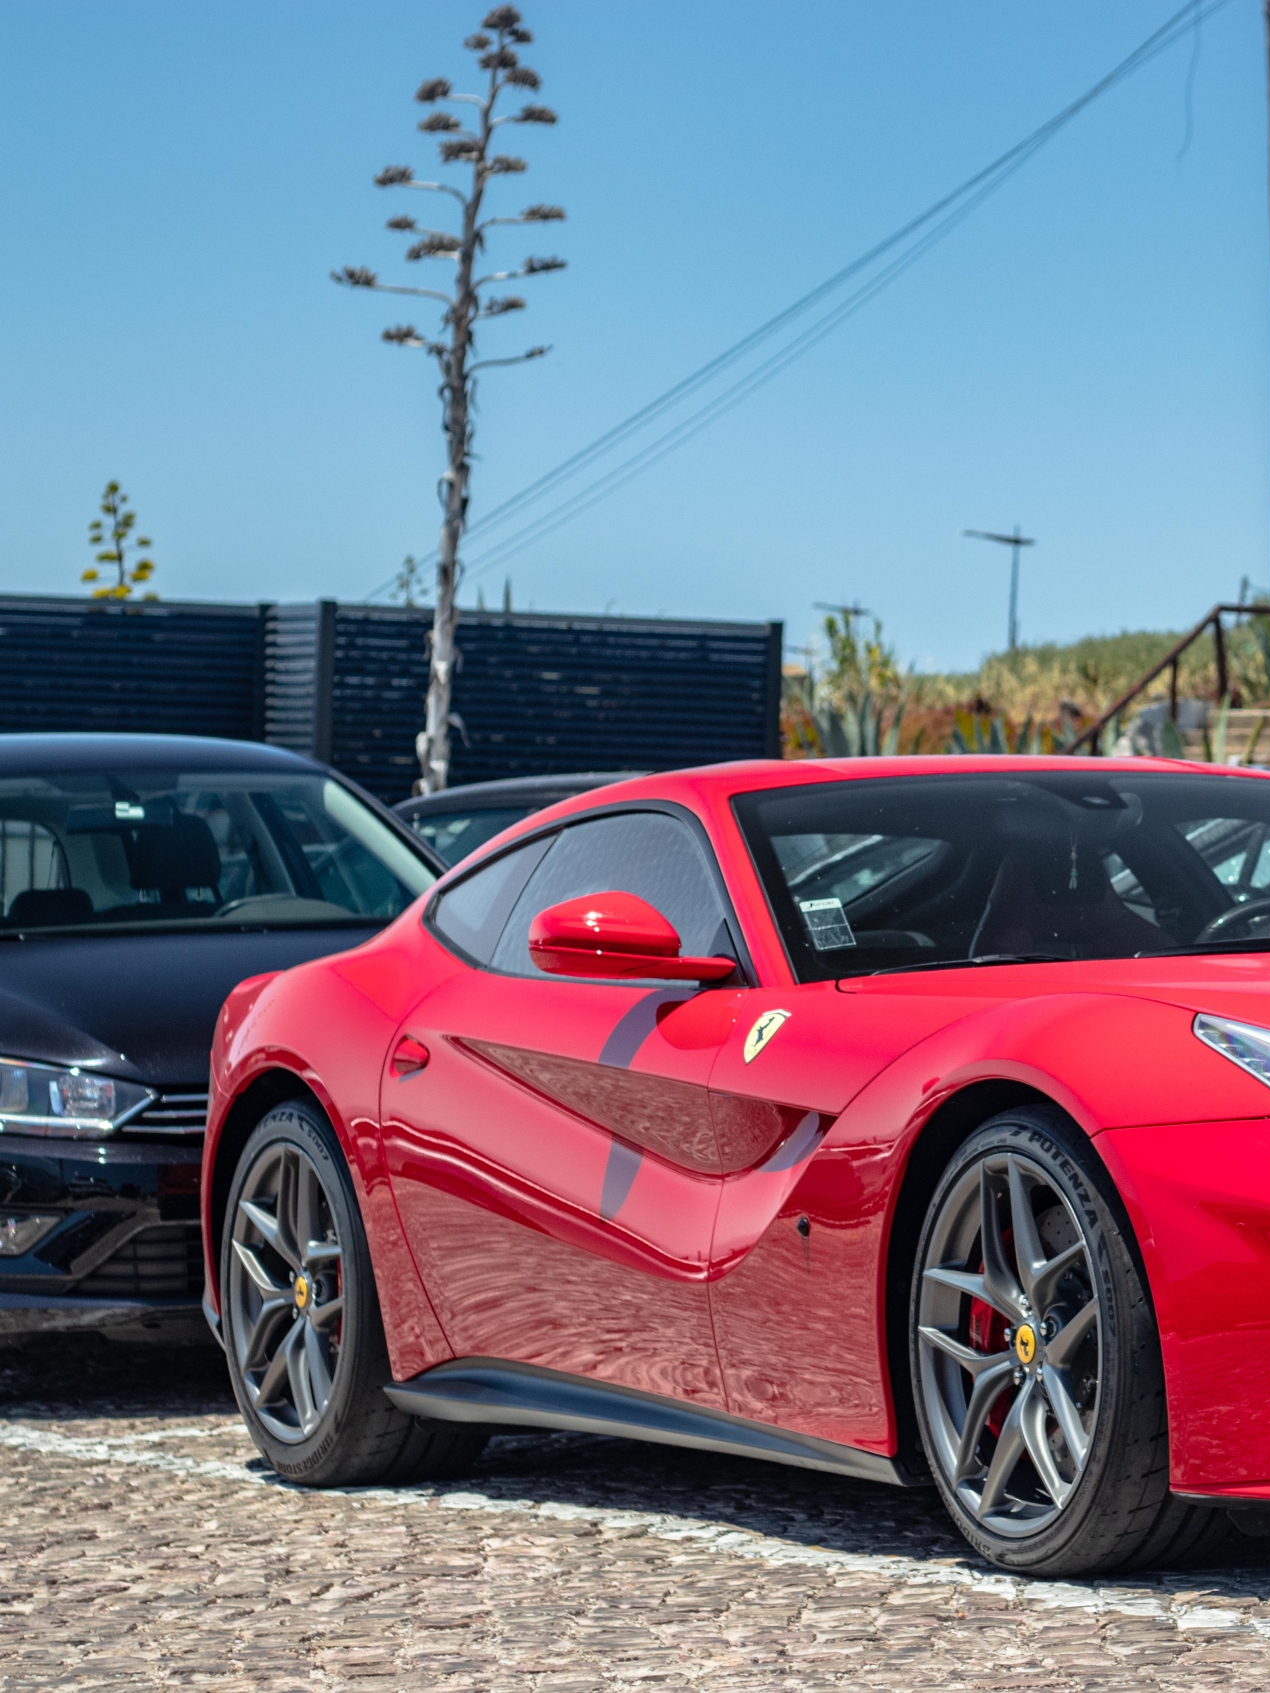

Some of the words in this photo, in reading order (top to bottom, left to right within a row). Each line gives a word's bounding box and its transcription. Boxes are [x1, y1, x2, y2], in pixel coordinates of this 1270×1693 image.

[306, 1129, 330, 1162] S007
[1027, 1130, 1099, 1229] POTENZA
[1101, 1269, 1117, 1338] S007
